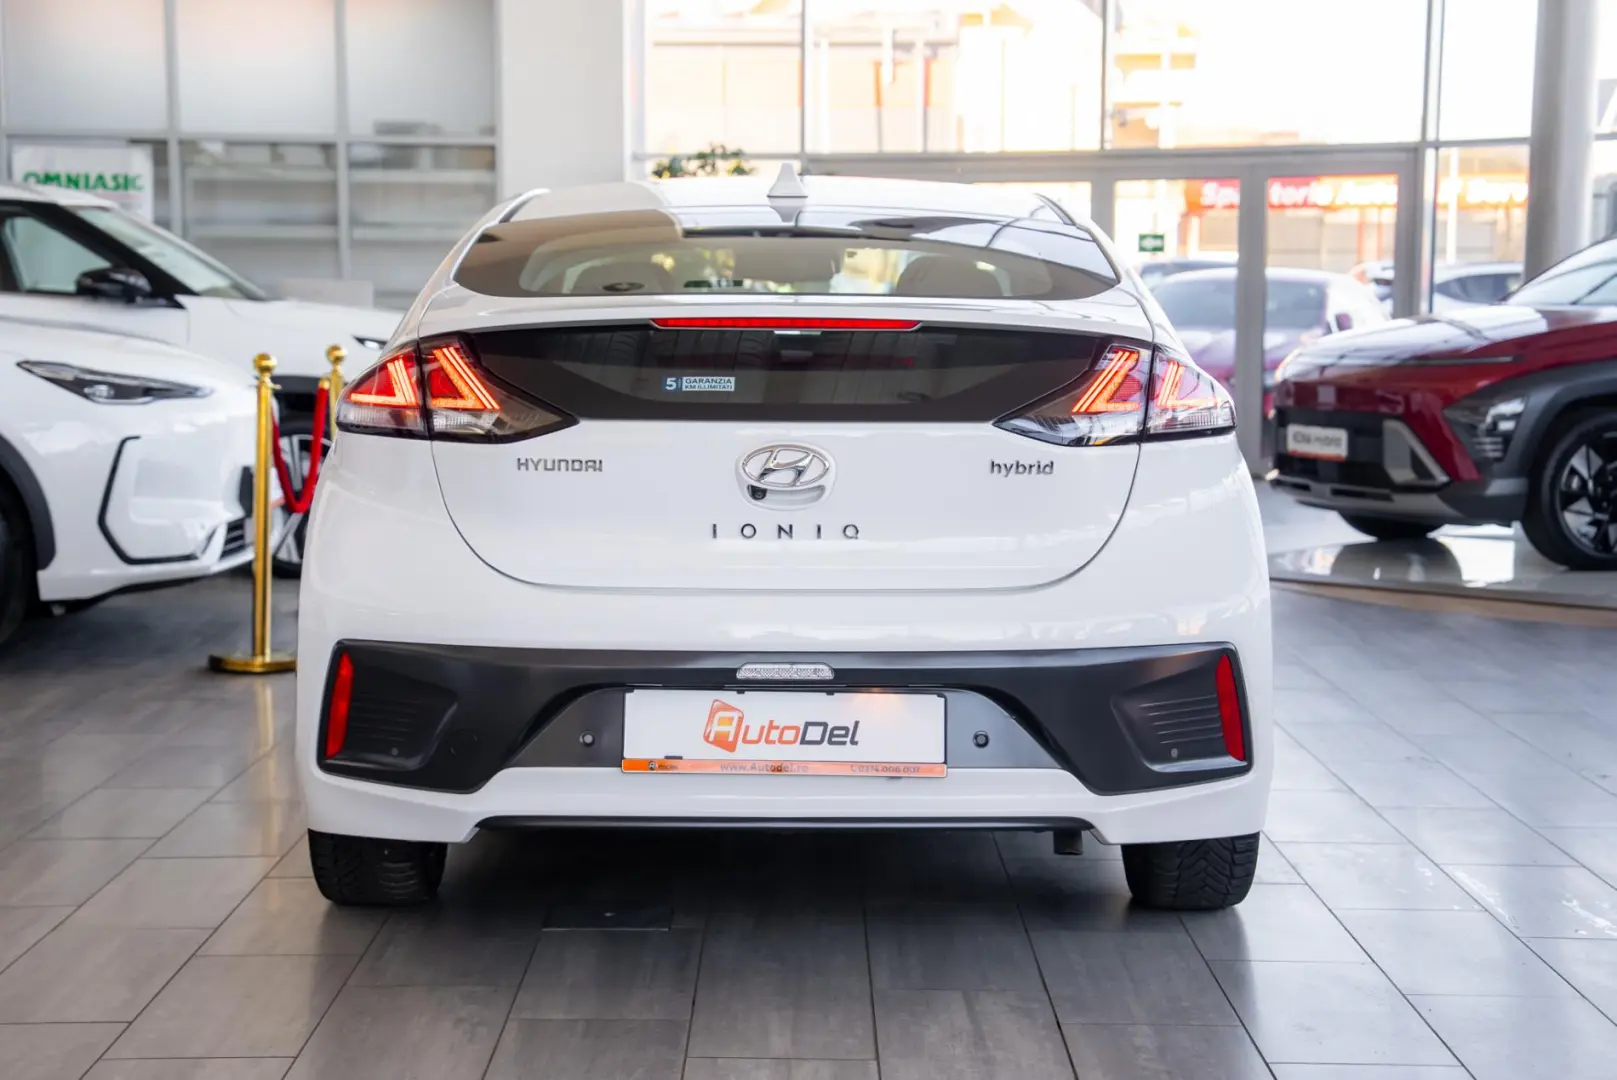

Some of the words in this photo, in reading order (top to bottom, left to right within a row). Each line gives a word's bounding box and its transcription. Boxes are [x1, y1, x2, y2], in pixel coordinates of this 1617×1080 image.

[666, 377, 677, 390] 5
[517, 457, 603, 472] HYUNDAI
[990, 460, 1054, 478] hybrid
[711, 523, 859, 540] IONIQ
[704, 699, 860, 753] AutoDel
